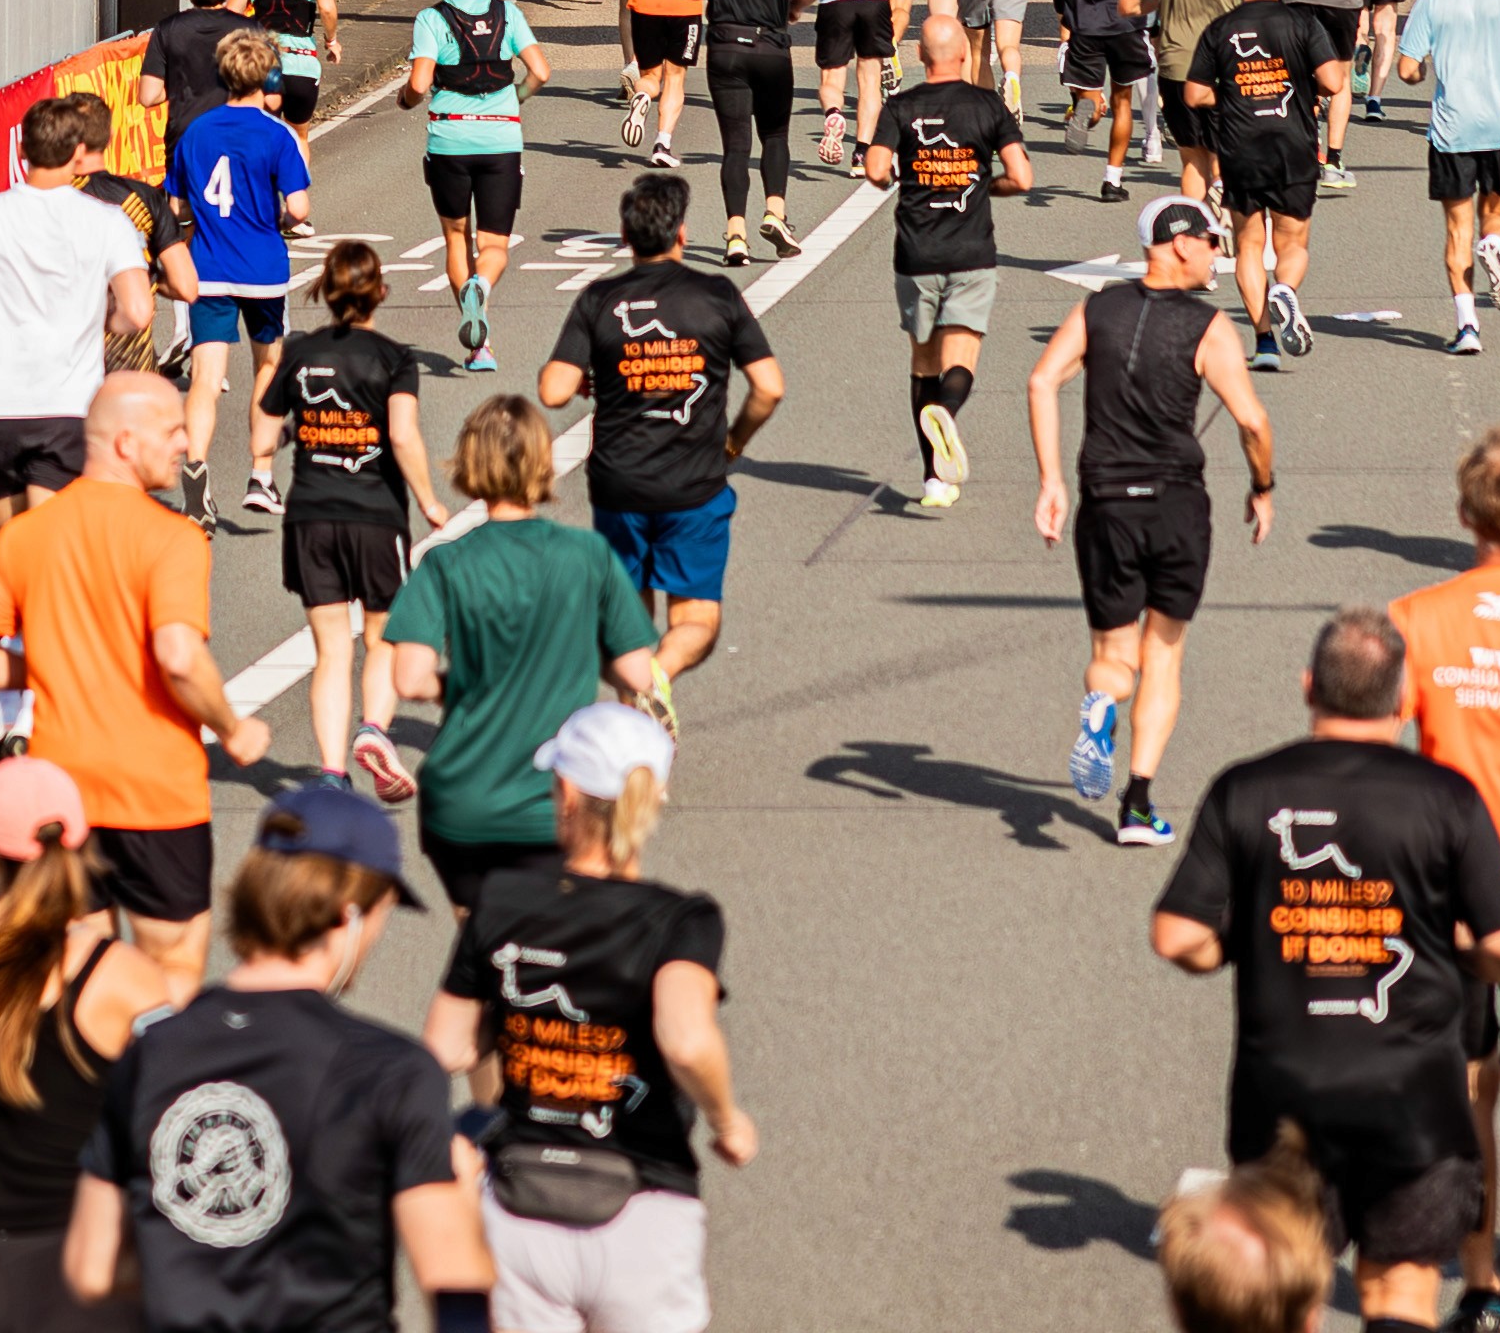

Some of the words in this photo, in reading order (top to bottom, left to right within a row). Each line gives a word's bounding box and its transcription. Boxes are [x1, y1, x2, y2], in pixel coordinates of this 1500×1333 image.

[1234, 69, 1288, 85] CONSIDER
[932, 148, 975, 159] MILES?
[912, 160, 978, 173] CONSIDER
[203, 154, 235, 218] 4
[623, 341, 641, 357] 10
[643, 338, 698, 356] MILES?
[619, 355, 705, 376] CONSIDER
[627, 376, 641, 392] IT
[303, 410, 317, 423] 10
[320, 410, 371, 426] MILES?
[299, 425, 380, 444] CONSIDER
[1280, 880, 1308, 902] 10
[1310, 879, 1395, 906] MILES?
[1270, 907, 1403, 933] CONSIDER
[1282, 937, 1306, 963] IT
[1307, 936, 1393, 964] DONE.
